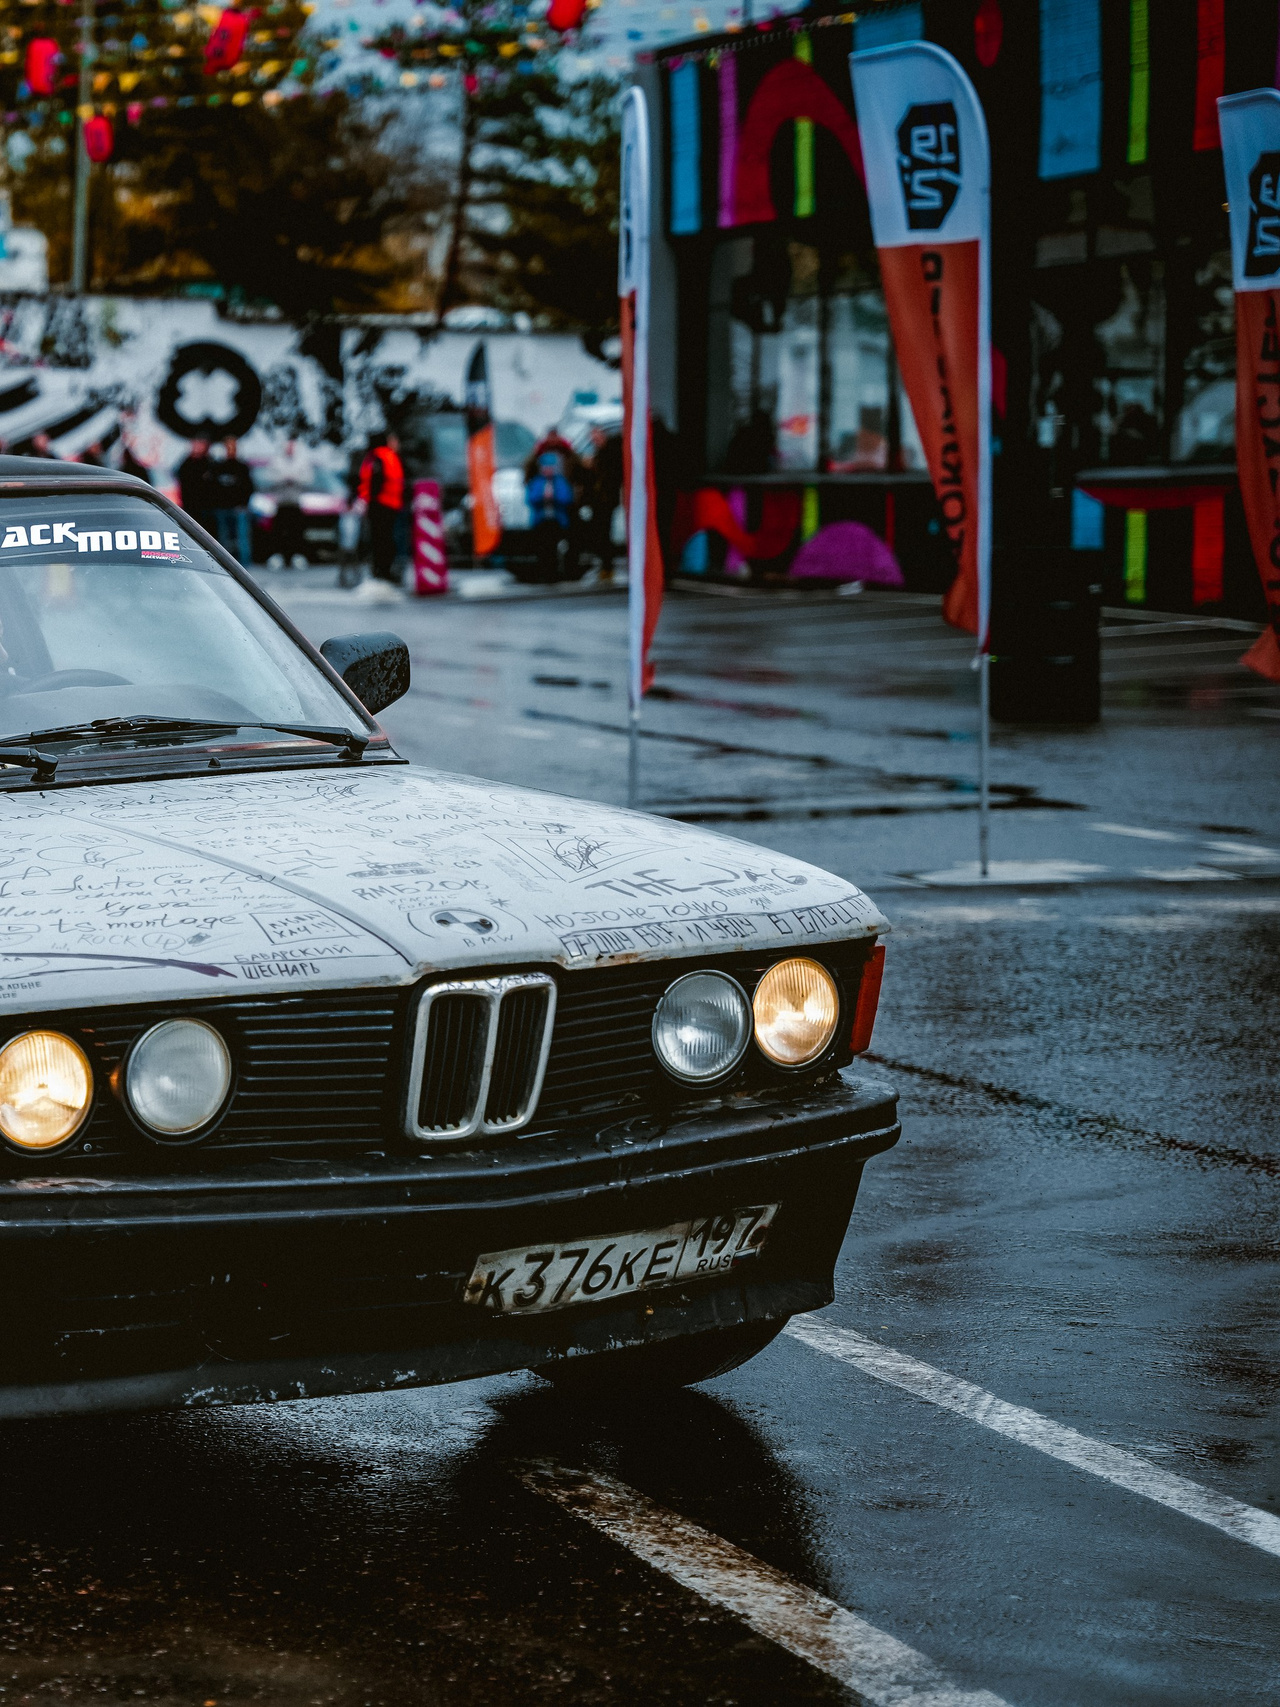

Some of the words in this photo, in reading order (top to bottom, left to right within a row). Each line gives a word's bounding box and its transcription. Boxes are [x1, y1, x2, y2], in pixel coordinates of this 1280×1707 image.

[77, 530, 180, 553] MODE
[141, 550, 180, 559] MOSCOW
[463, 934, 515, 949] BMW
[688, 1206, 766, 1259] 197
[695, 1254, 731, 1274] RUS
